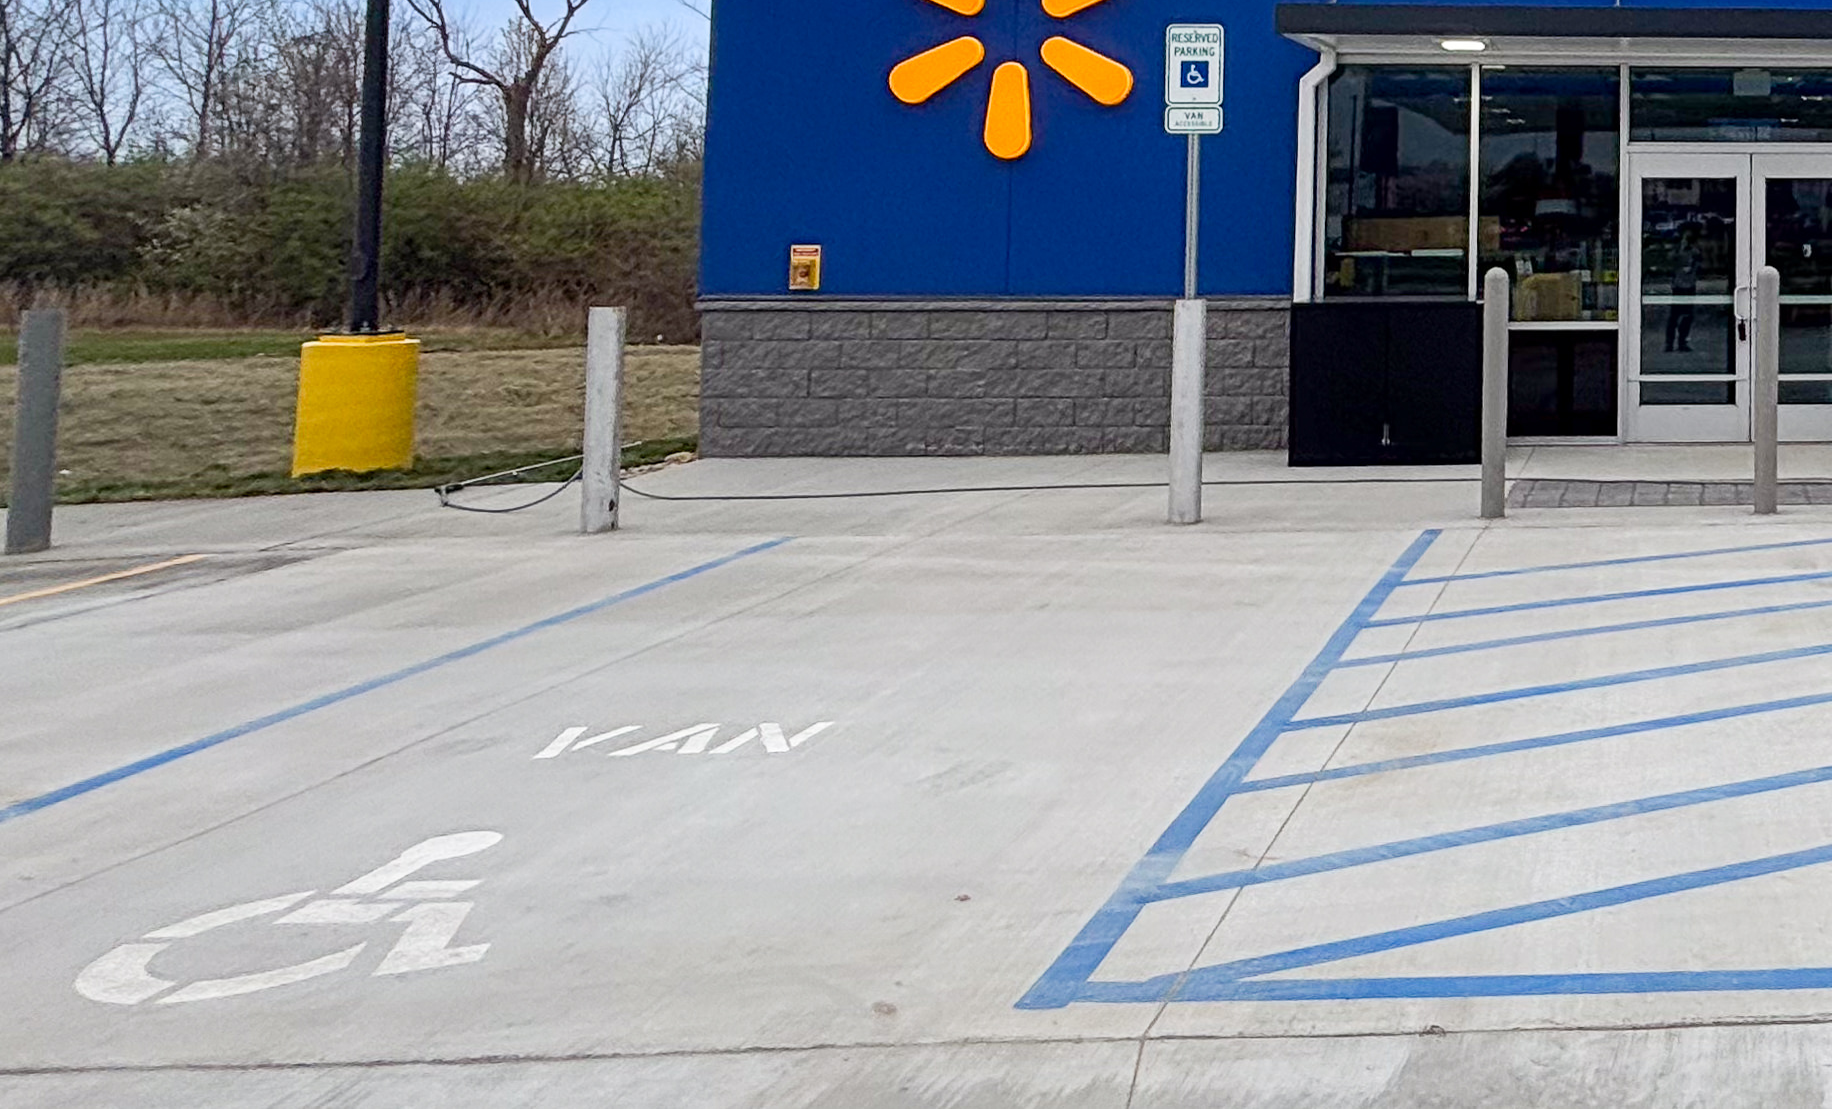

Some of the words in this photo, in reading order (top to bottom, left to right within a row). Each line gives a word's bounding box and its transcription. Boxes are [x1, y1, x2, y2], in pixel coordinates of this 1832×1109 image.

[1171, 33, 1219, 43] RESERVED
[1174, 46, 1215, 57] PARKING
[1184, 111, 1204, 120] VAN
[531, 721, 837, 759] VAN
